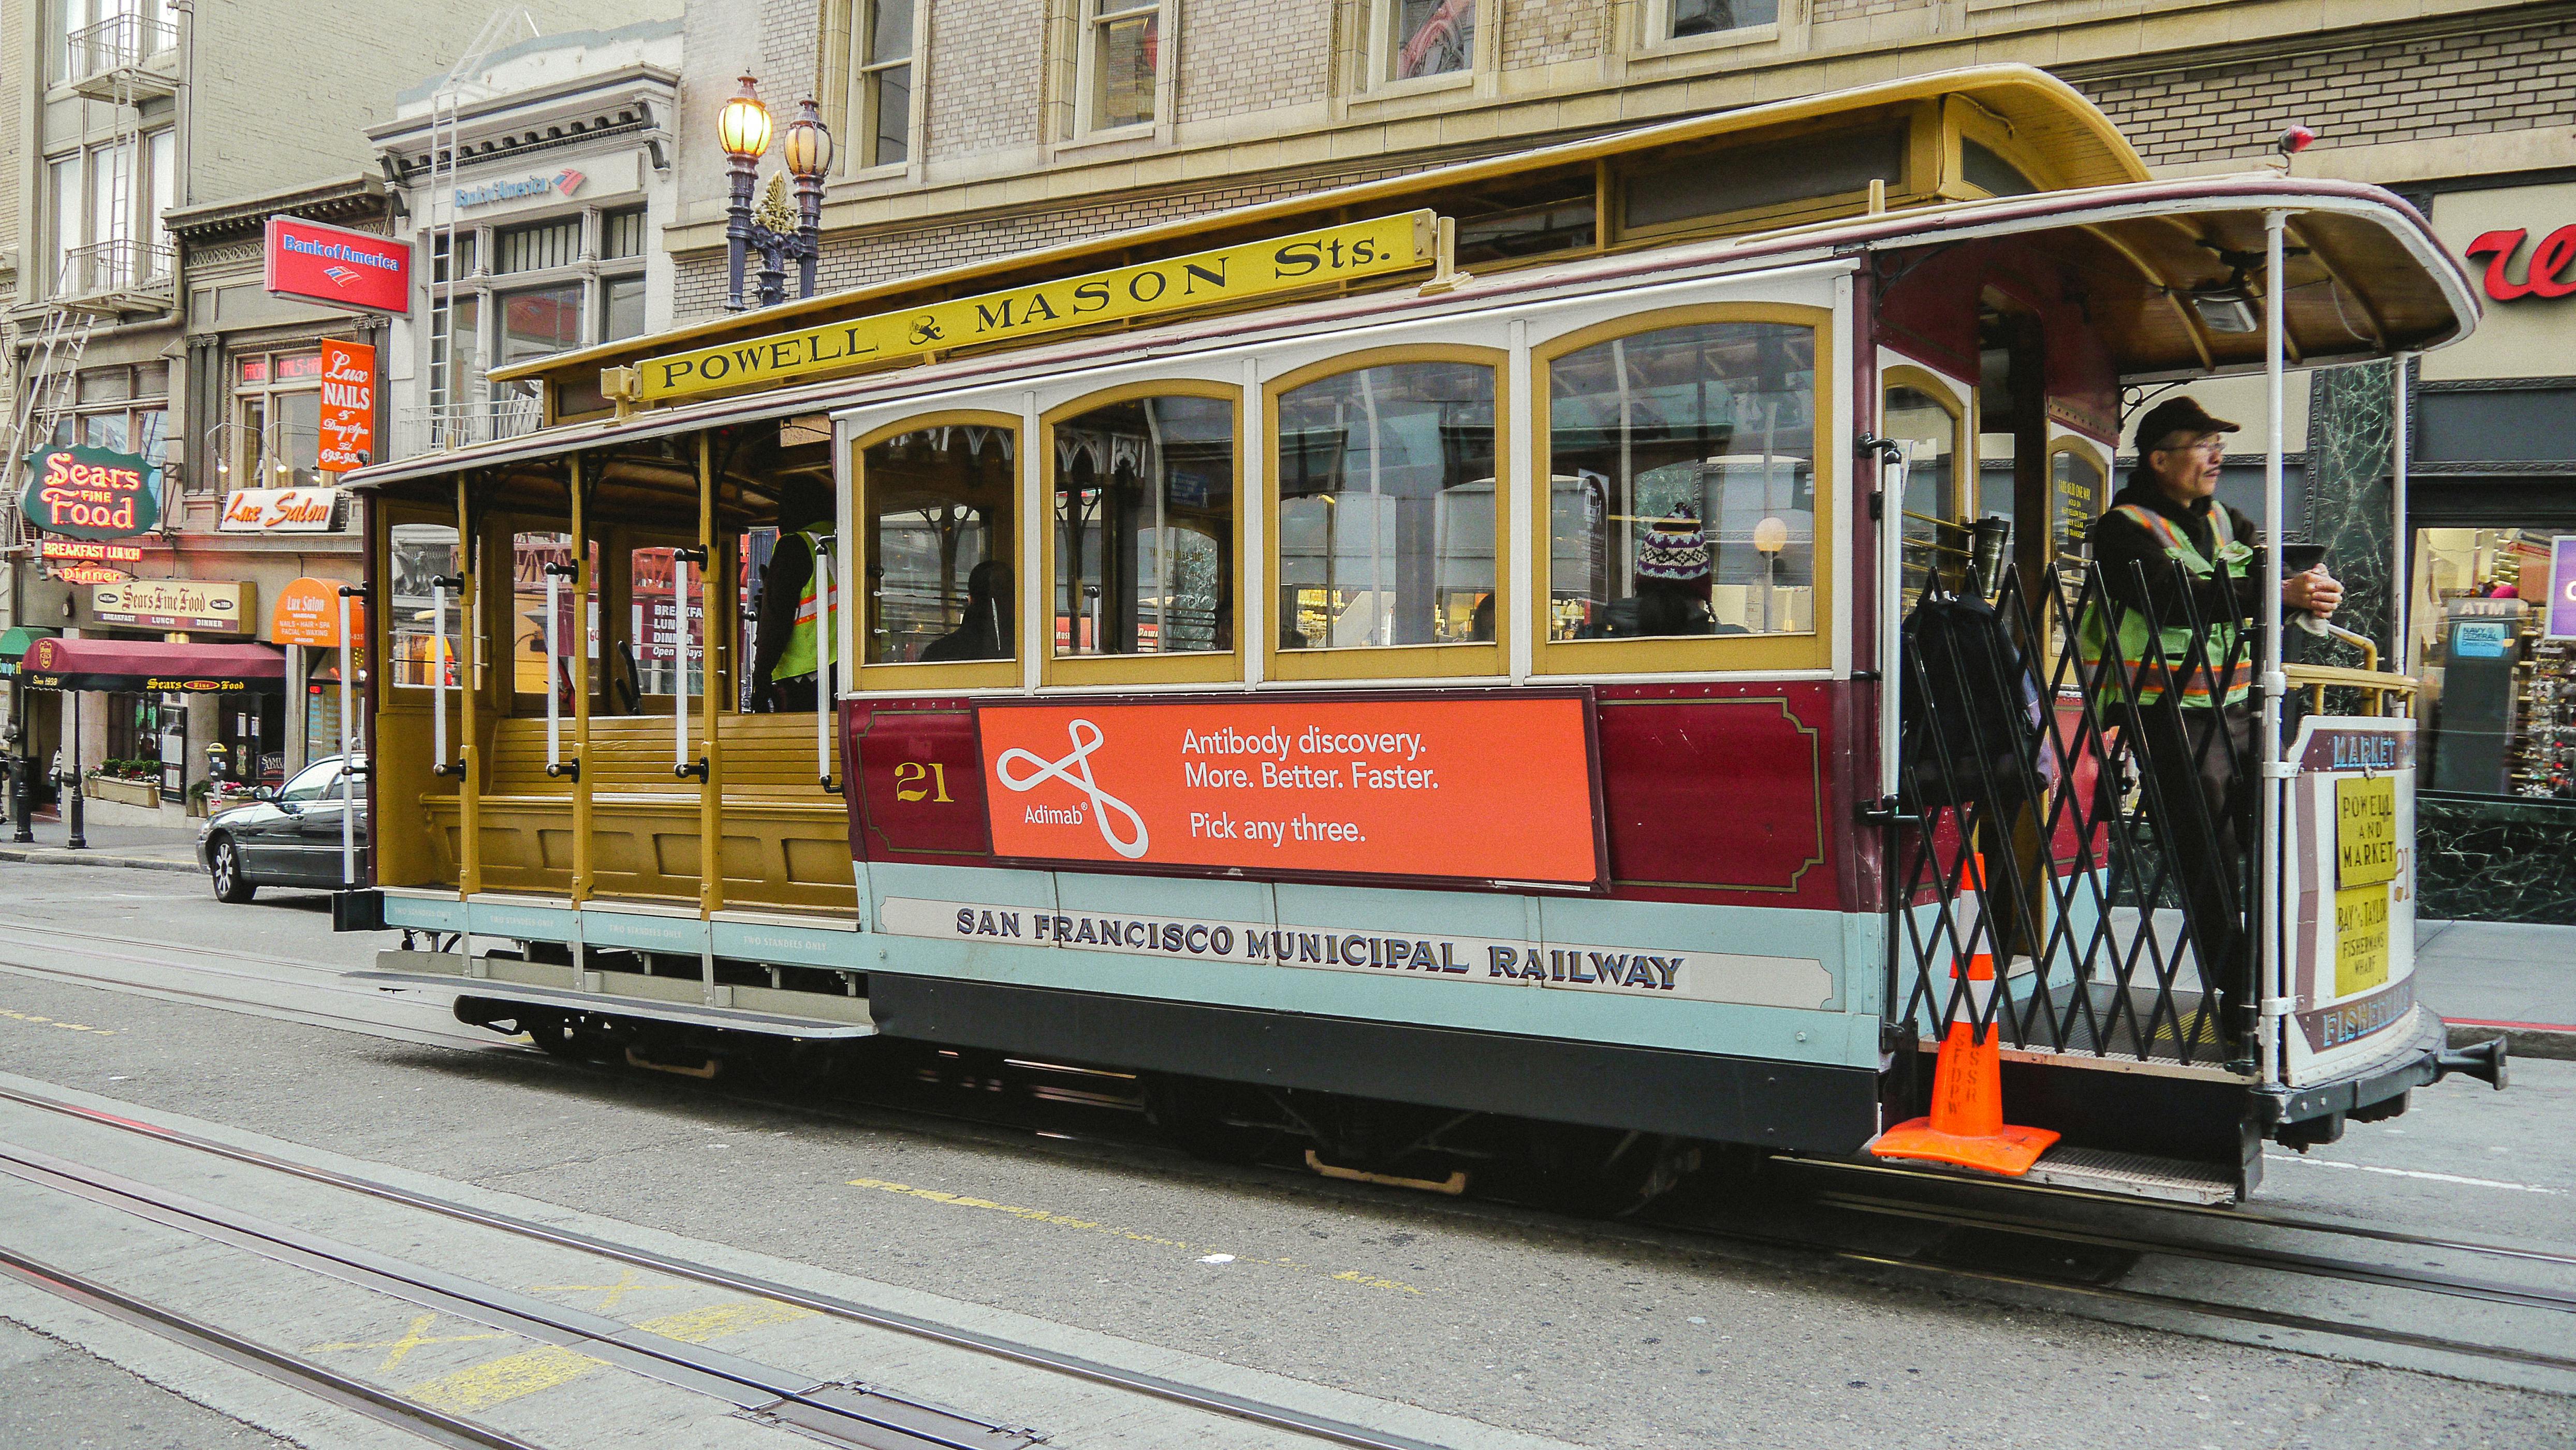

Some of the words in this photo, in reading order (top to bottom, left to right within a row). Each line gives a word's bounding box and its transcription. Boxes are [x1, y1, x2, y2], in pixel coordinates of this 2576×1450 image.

[456, 185, 486, 207] Bank
[497, 176, 547, 200] America
[283, 234, 324, 258] Bank
[324, 244, 341, 259] of
[341, 245, 400, 271] America
[662, 328, 879, 388] POWELL
[909, 315, 945, 345] &
[975, 256, 1230, 333] MASON
[1275, 237, 1391, 279] Sts.
[325, 351, 368, 383] Lux
[324, 382, 370, 410] NAILS
[323, 418, 347, 440] Day
[347, 422, 369, 442] Spa
[44, 452, 140, 490] Sears
[40, 487, 135, 529] Food
[81, 490, 112, 503] FINE
[224, 492, 263, 522] Lux
[264, 491, 329, 527] Salon
[42, 542, 104, 558] BREAKFAST
[64, 568, 120, 582] Dinner
[122, 584, 153, 612] Sears
[154, 586, 178, 612] Fine
[179, 587, 206, 613] Food
[287, 596, 301, 611] Lux
[302, 596, 325, 612] Salon
[2460, 602, 2506, 616] ATM
[103, 613, 136, 622] BREAKFAST
[196, 619, 223, 628] DINNER
[653, 646, 675, 658] Open
[147, 678, 182, 690] Sears
[221, 681, 244, 690] Food
[1182, 726, 1291, 762] Antibody
[1298, 725, 1426, 761] discovery.
[2334, 735, 2396, 768] MARKET
[895, 762, 954, 802] 21
[1184, 762, 1254, 788] More.
[1261, 762, 1344, 789] Better.
[1352, 761, 1439, 789] Faster.
[2344, 794, 2392, 819] POWELL
[1190, 811, 1237, 838] Pick
[1244, 820, 1285, 848] any
[1291, 813, 1366, 842] three.
[2359, 822, 2382, 839] AND
[2343, 841, 2394, 868] MARKET
[2338, 905, 2354, 933] BAY
[664, 930, 682, 938] ONLY
[743, 936, 761, 945] TWO
[764, 937, 803, 949] STANDEES
[806, 941, 827, 951] ONLY
[956, 907, 1021, 938] SAN
[1034, 915, 1234, 955] FRANCISCO
[1245, 929, 1470, 974] MUNICIPAL
[1488, 946, 1685, 991] RAILWAY
